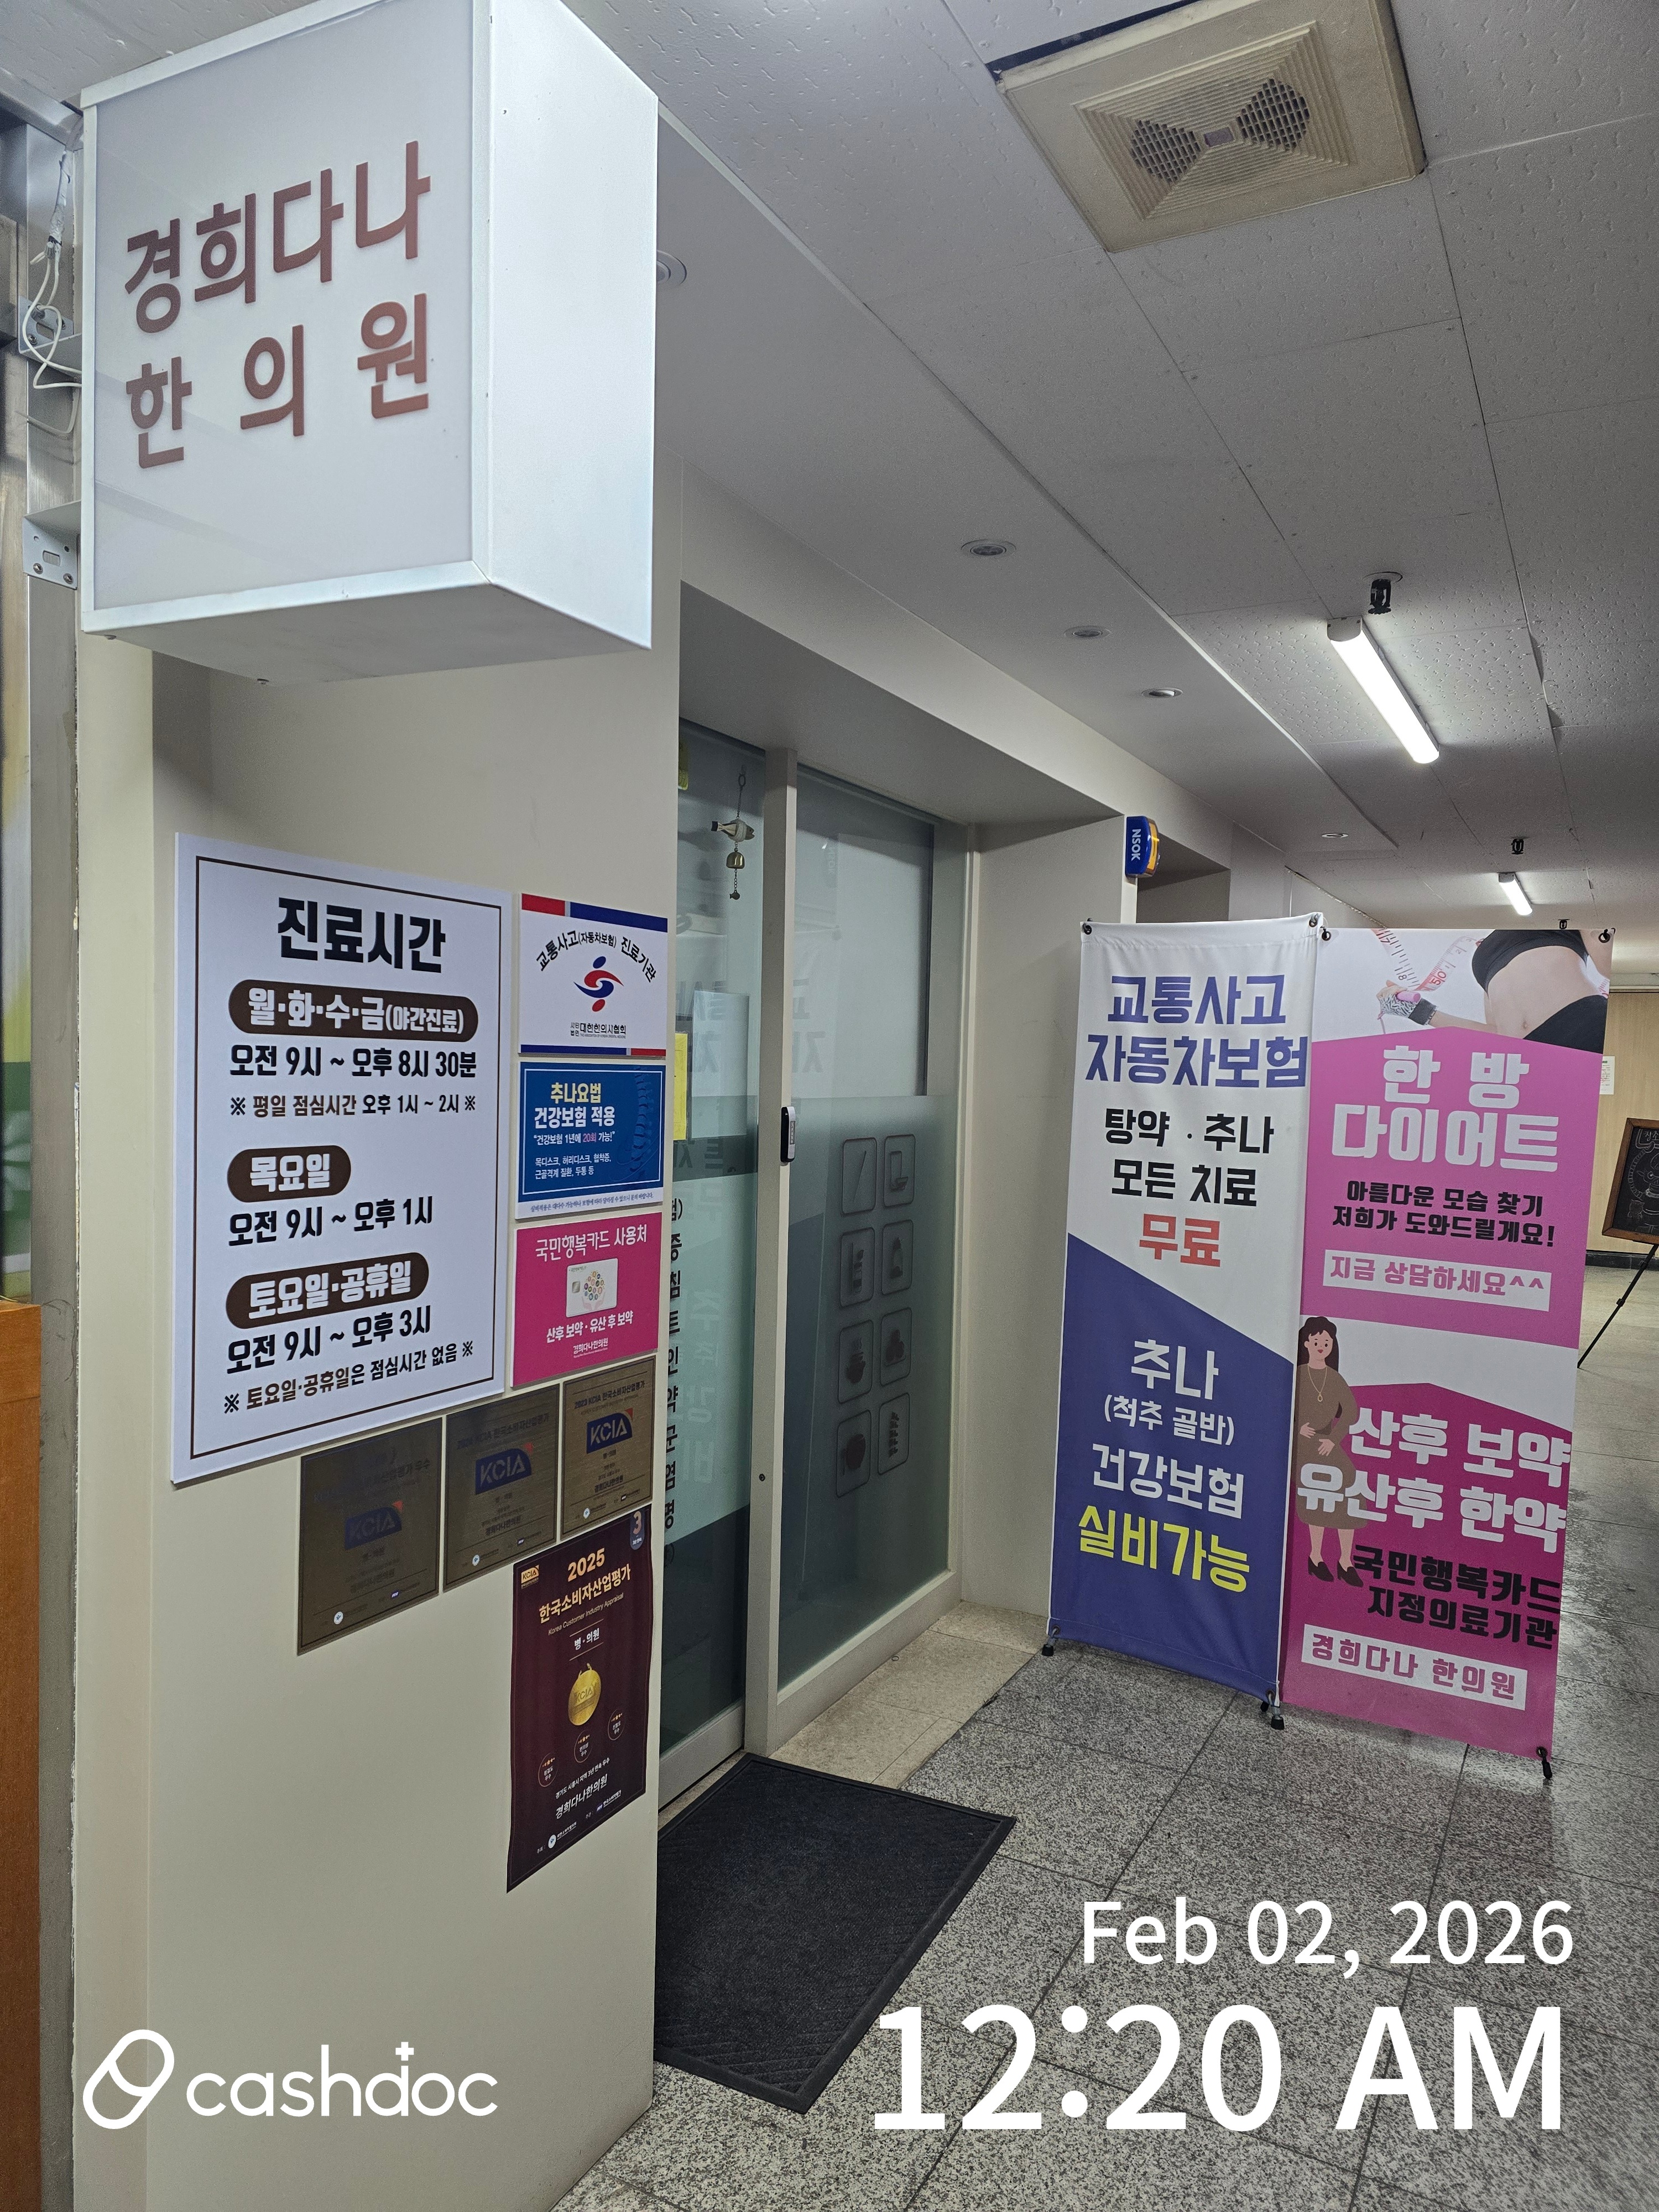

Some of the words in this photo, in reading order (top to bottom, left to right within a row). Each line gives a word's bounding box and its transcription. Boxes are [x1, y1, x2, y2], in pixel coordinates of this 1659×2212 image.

[124, 140, 431, 333] 경희다나
[1131, 828, 1141, 861] NSOK
[278, 897, 446, 973] 진료시간
[621, 937, 656, 983] 진료기관
[1108, 974, 1286, 1025] 교통사고
[580, 1022, 626, 1035] 대한한의사협회
[230, 1045, 276, 1076] 오전
[286, 1047, 321, 1076] 9시
[352, 1047, 392, 1077] 오후
[399, 1051, 429, 1077] 8시
[435, 1051, 476, 1078] 30분
[1085, 1034, 1309, 1088] 자동차보험
[253, 1095, 286, 1118] 평일
[293, 1095, 357, 1116] 점심시간
[362, 1094, 390, 1114] 오후
[398, 1095, 418, 1114] 1시
[439, 1094, 459, 1113] 2시
[550, 1082, 601, 1104] 추나요법
[534, 1107, 586, 1129] 건강보험
[591, 1106, 615, 1126] 적용
[565, 1133, 581, 1144] 1년에
[583, 1133, 597, 1142] 20회
[1105, 1108, 1170, 1147] 탕약
[1204, 1113, 1274, 1154] 추나
[1332, 1104, 1559, 1172] 다이어트
[250, 1153, 330, 1192] 목요일
[535, 1168, 559, 1180] 근골격계
[575, 1166, 587, 1176] 두통
[588, 1166, 594, 1175] 등
[1112, 1159, 1176, 1199] 모든
[1190, 1165, 1257, 1207] 치료
[228, 1211, 276, 1246] 오전
[286, 1207, 322, 1238] 9시
[354, 1198, 395, 1232] 오후
[403, 1196, 433, 1225] 1시
[1347, 1180, 1434, 1207] 아름다운
[1443, 1187, 1488, 1211] 모습
[1498, 1191, 1543, 1217] 찾기
[535, 1230, 611, 1262] 국민행복카드
[614, 1224, 647, 1246] 사용처
[1139, 1213, 1220, 1267] 무료
[1332, 1205, 1397, 1231] 저희가
[1405, 1212, 1554, 1247] 도와드릴게요!
[248, 1260, 411, 1319] 토요일·공휴일
[1331, 1255, 1375, 1282] 지금
[227, 1334, 275, 1374] 오전
[285, 1326, 321, 1361] 9시
[352, 1312, 393, 1348] 오후
[400, 1305, 431, 1335] 3시
[546, 1326, 565, 1343] 산후
[566, 1321, 583, 1338] 보약
[590, 1316, 606, 1333] 유산
[608, 1314, 616, 1329] 후
[618, 1310, 633, 1326] 보약
[573, 1337, 608, 1354] 경희다나한의원
[247, 1364, 364, 1410] 토요일·공휴일은
[371, 1350, 426, 1381] 점심시간
[431, 1343, 457, 1366] 없음
[1131, 1339, 1219, 1400] 추나
[590, 1418, 627, 1446] KCIA
[1104, 1394, 1162, 1430] (척추
[1173, 1407, 1234, 1446] 골반)
[481, 1454, 525, 1486] KCIA
[1348, 1407, 1448, 1465] 산후
[1463, 1423, 1571, 1488] 보약
[1093, 1443, 1244, 1519] 건강보험
[348, 1512, 395, 1541] KCIA
[633, 1511, 641, 1535] 3
[1297, 1463, 1444, 1528] 유산후
[1460, 1485, 1567, 1554] 한약
[567, 1548, 605, 1582] 2025
[1078, 1505, 1250, 1592] 실비가능
[523, 1569, 537, 1580] KCIA
[539, 1563, 631, 1624] 한국소비자산업평가
[1353, 1544, 1561, 1614] 국민행복카드
[548, 1625, 562, 1636] Korea
[562, 1613, 585, 1629] Customer
[586, 1604, 603, 1617] Industry
[604, 1593, 624, 1608] Appraisal
[1367, 1585, 1558, 1650] 지정의료기관
[1312, 1633, 1418, 1679] 경희다나
[1432, 1657, 1515, 1701] 한의원
[555, 1787, 567, 1799] 경기도
[555, 1773, 608, 1819] 경희다나한의원
